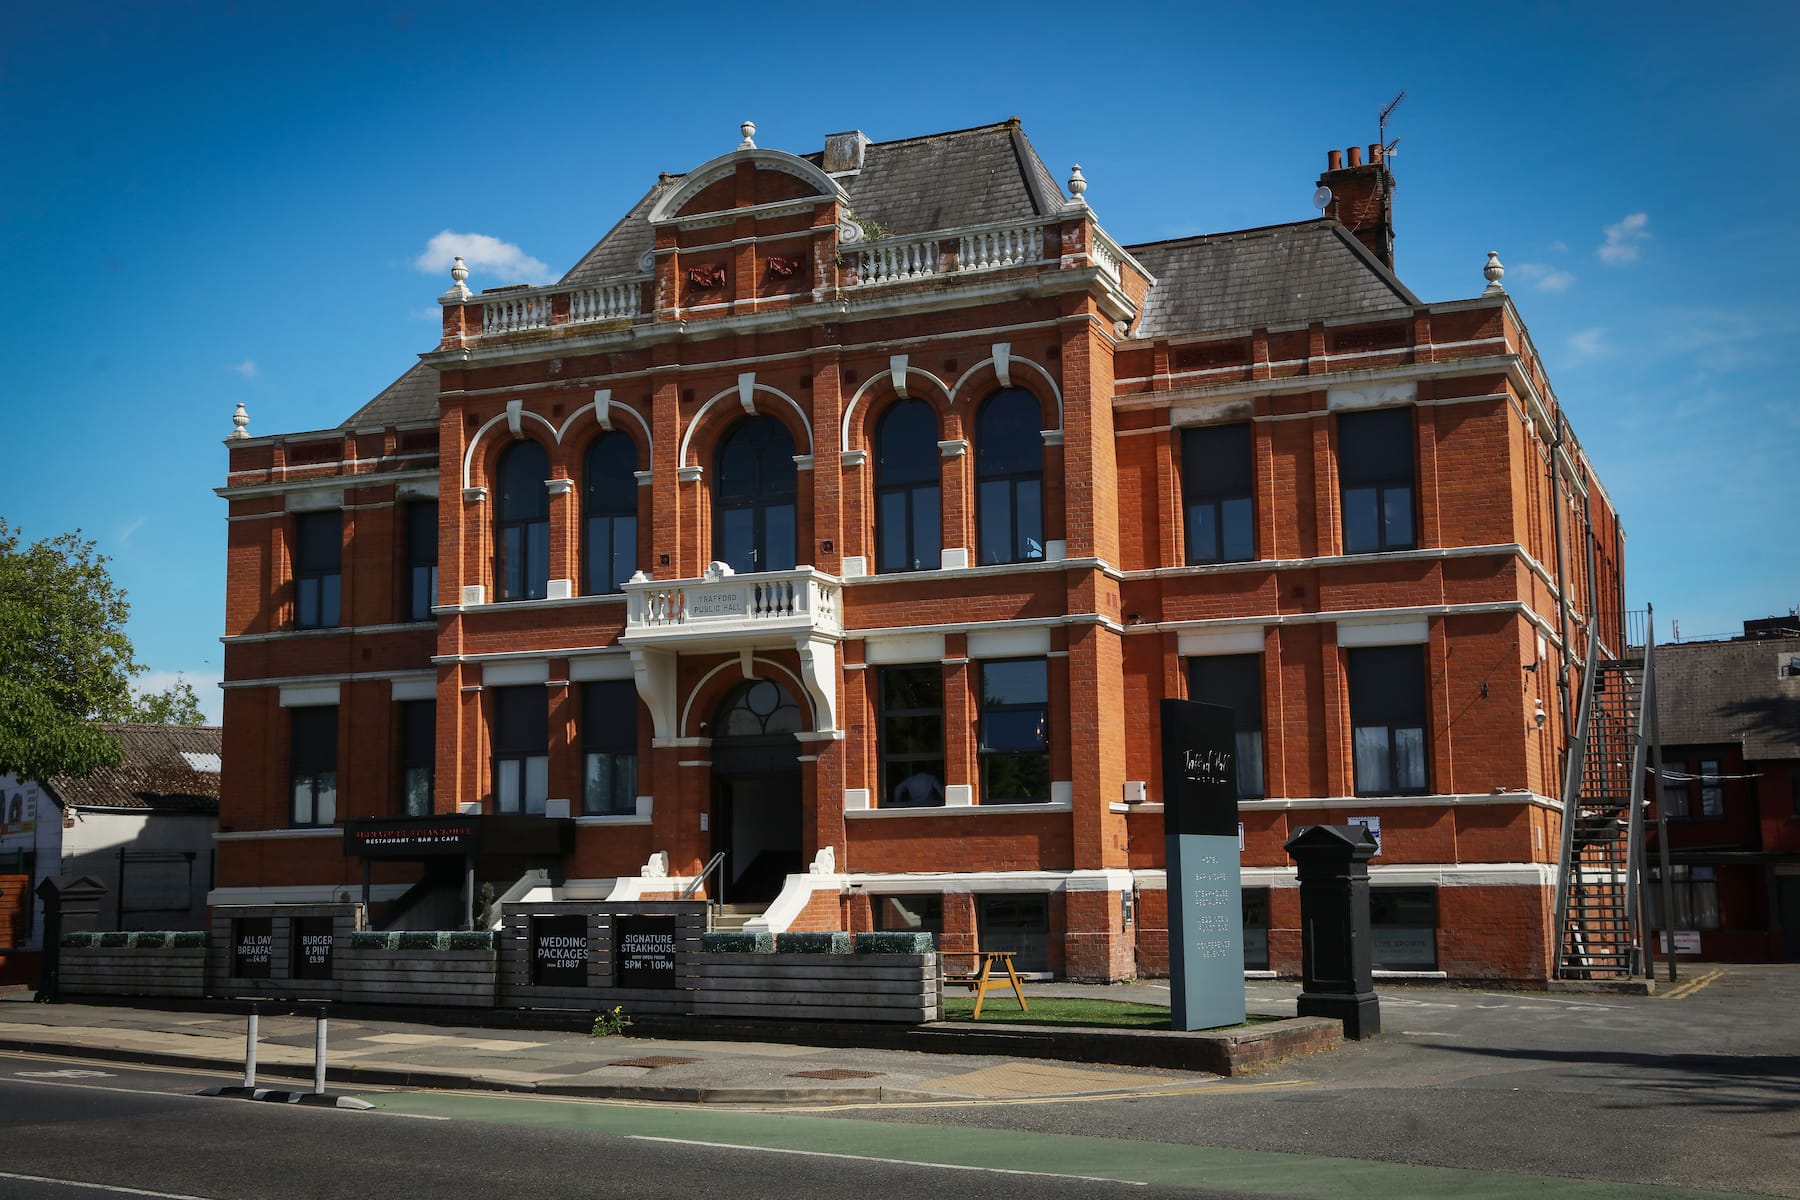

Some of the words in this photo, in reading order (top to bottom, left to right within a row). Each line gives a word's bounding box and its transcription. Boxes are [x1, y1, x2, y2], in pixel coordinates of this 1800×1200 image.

[698, 594, 737, 603] TRAFFORD
[694, 605, 720, 613] PUBLIC
[724, 603, 741, 611] HALL
[243, 935, 256, 945] ALL
[258, 935, 272, 944] DAY
[302, 935, 333, 945] BURGER
[540, 936, 587, 948] WEDDING
[624, 934, 673, 943] SIGNATURE
[237, 945, 273, 955] BREAKFAS
[305, 945, 310, 955] &
[312, 945, 330, 955] PINT
[620, 943, 677, 953] STEAKHOUSE
[537, 948, 589, 960] PACKAGES
[309, 955, 325, 964] £9.99
[557, 959, 580, 968] £1887
[624, 960, 642, 970] 5PM
[650, 960, 673, 970] 10PM
